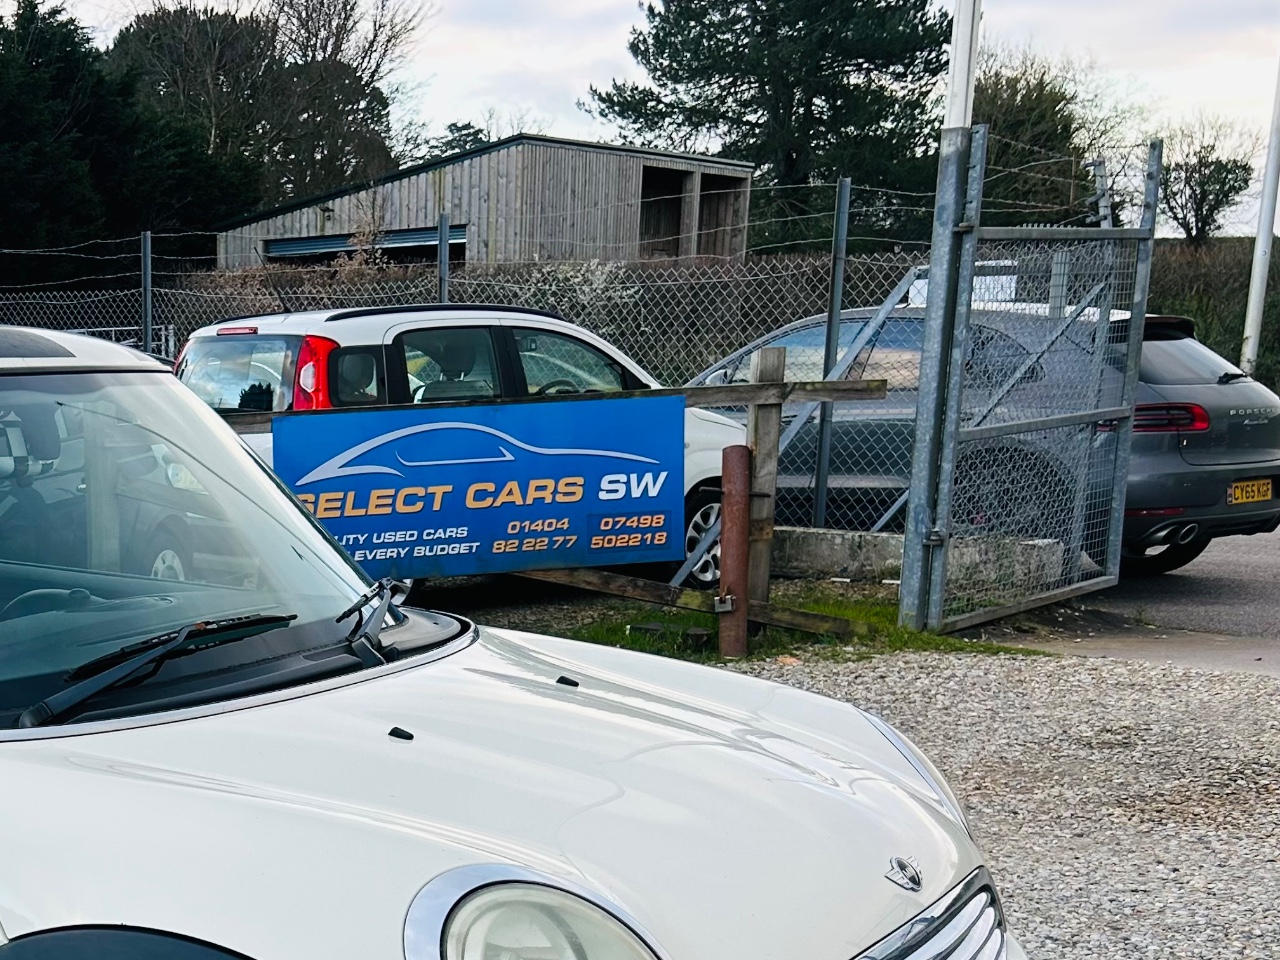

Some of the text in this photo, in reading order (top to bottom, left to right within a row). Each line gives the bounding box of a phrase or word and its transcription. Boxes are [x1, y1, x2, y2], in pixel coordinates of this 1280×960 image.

[465, 476, 585, 510] CARS
[598, 471, 669, 500] SW
[1233, 484, 1256, 502] CY65
[507, 517, 570, 535] 01404
[600, 514, 666, 532] 07498
[372, 529, 419, 545] USED
[422, 526, 469, 541] CARS
[492, 535, 578, 554] 82 22 77
[590, 531, 668, 550] 502218
[354, 542, 481, 562] EVERY BUDGET
